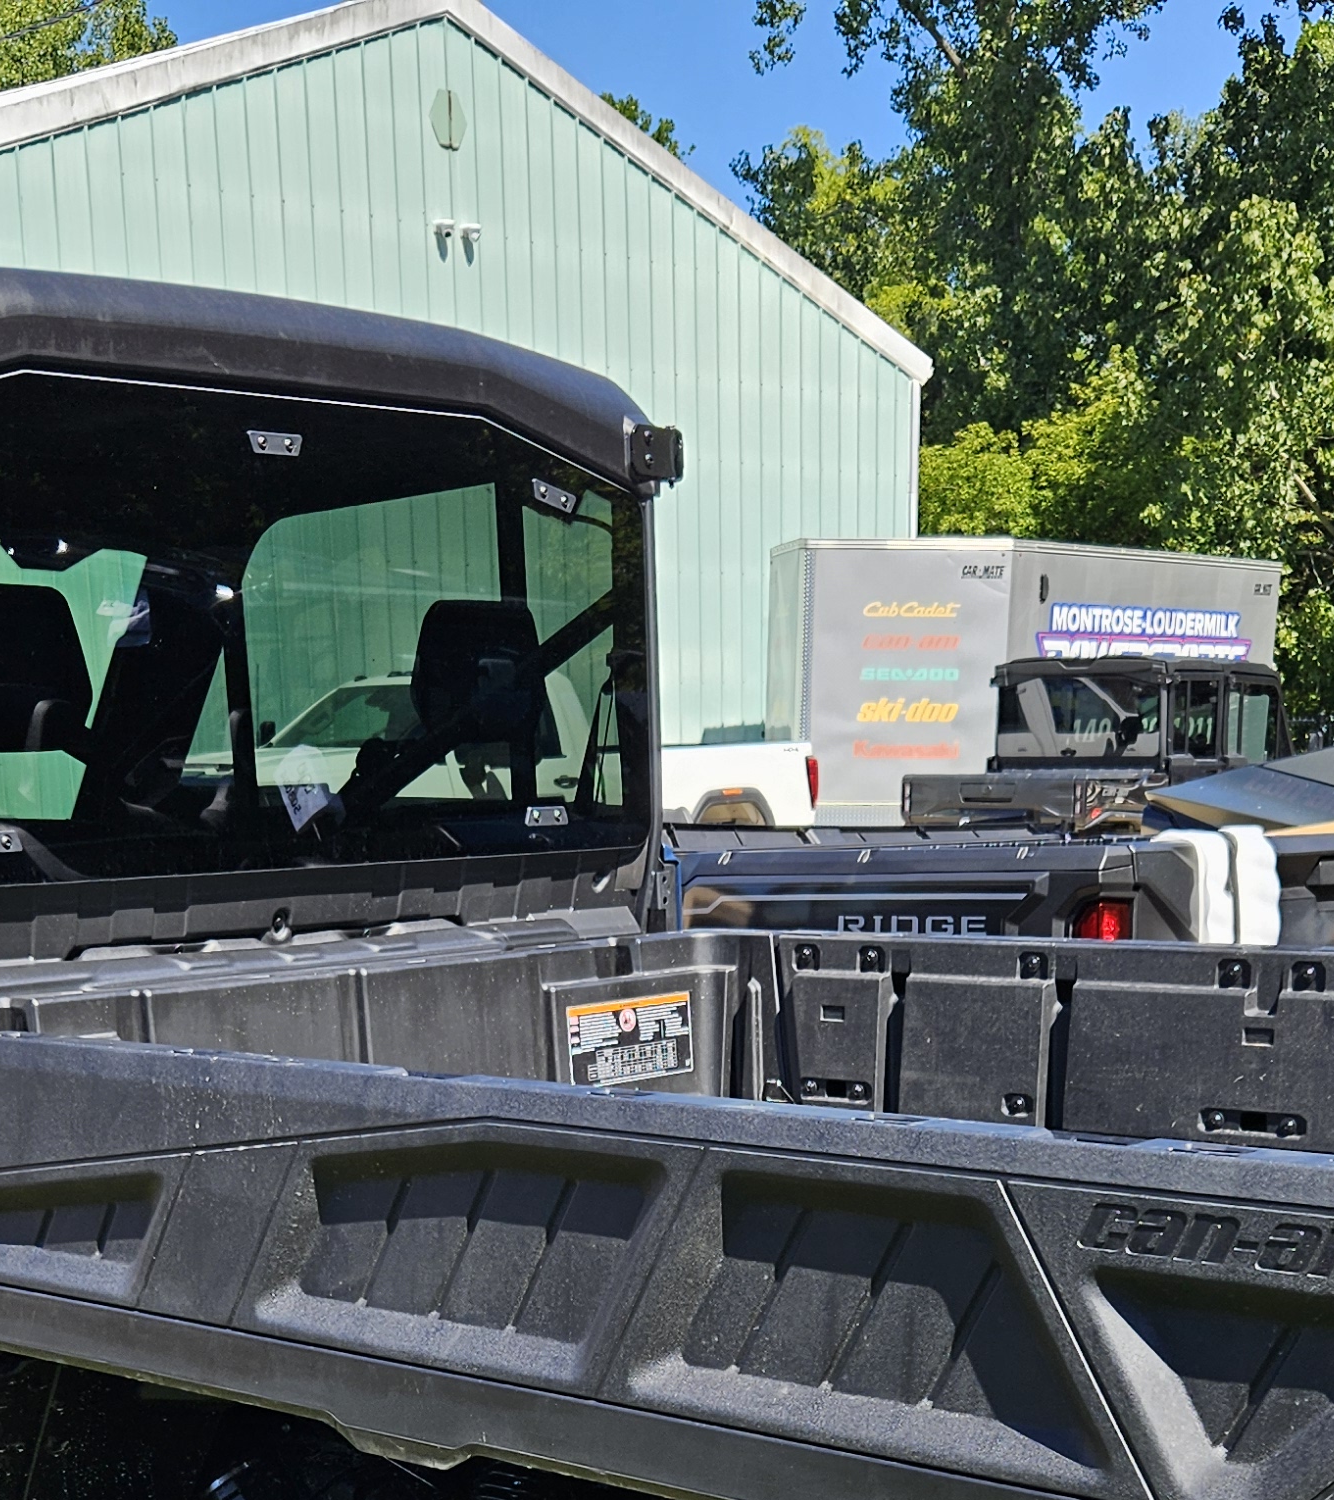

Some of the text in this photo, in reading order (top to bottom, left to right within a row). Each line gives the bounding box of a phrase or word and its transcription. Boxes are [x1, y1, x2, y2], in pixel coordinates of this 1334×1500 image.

[863, 602, 961, 618] Cub Cadet
[857, 697, 959, 722] ski-doo
[837, 915, 987, 936] RIDGE
